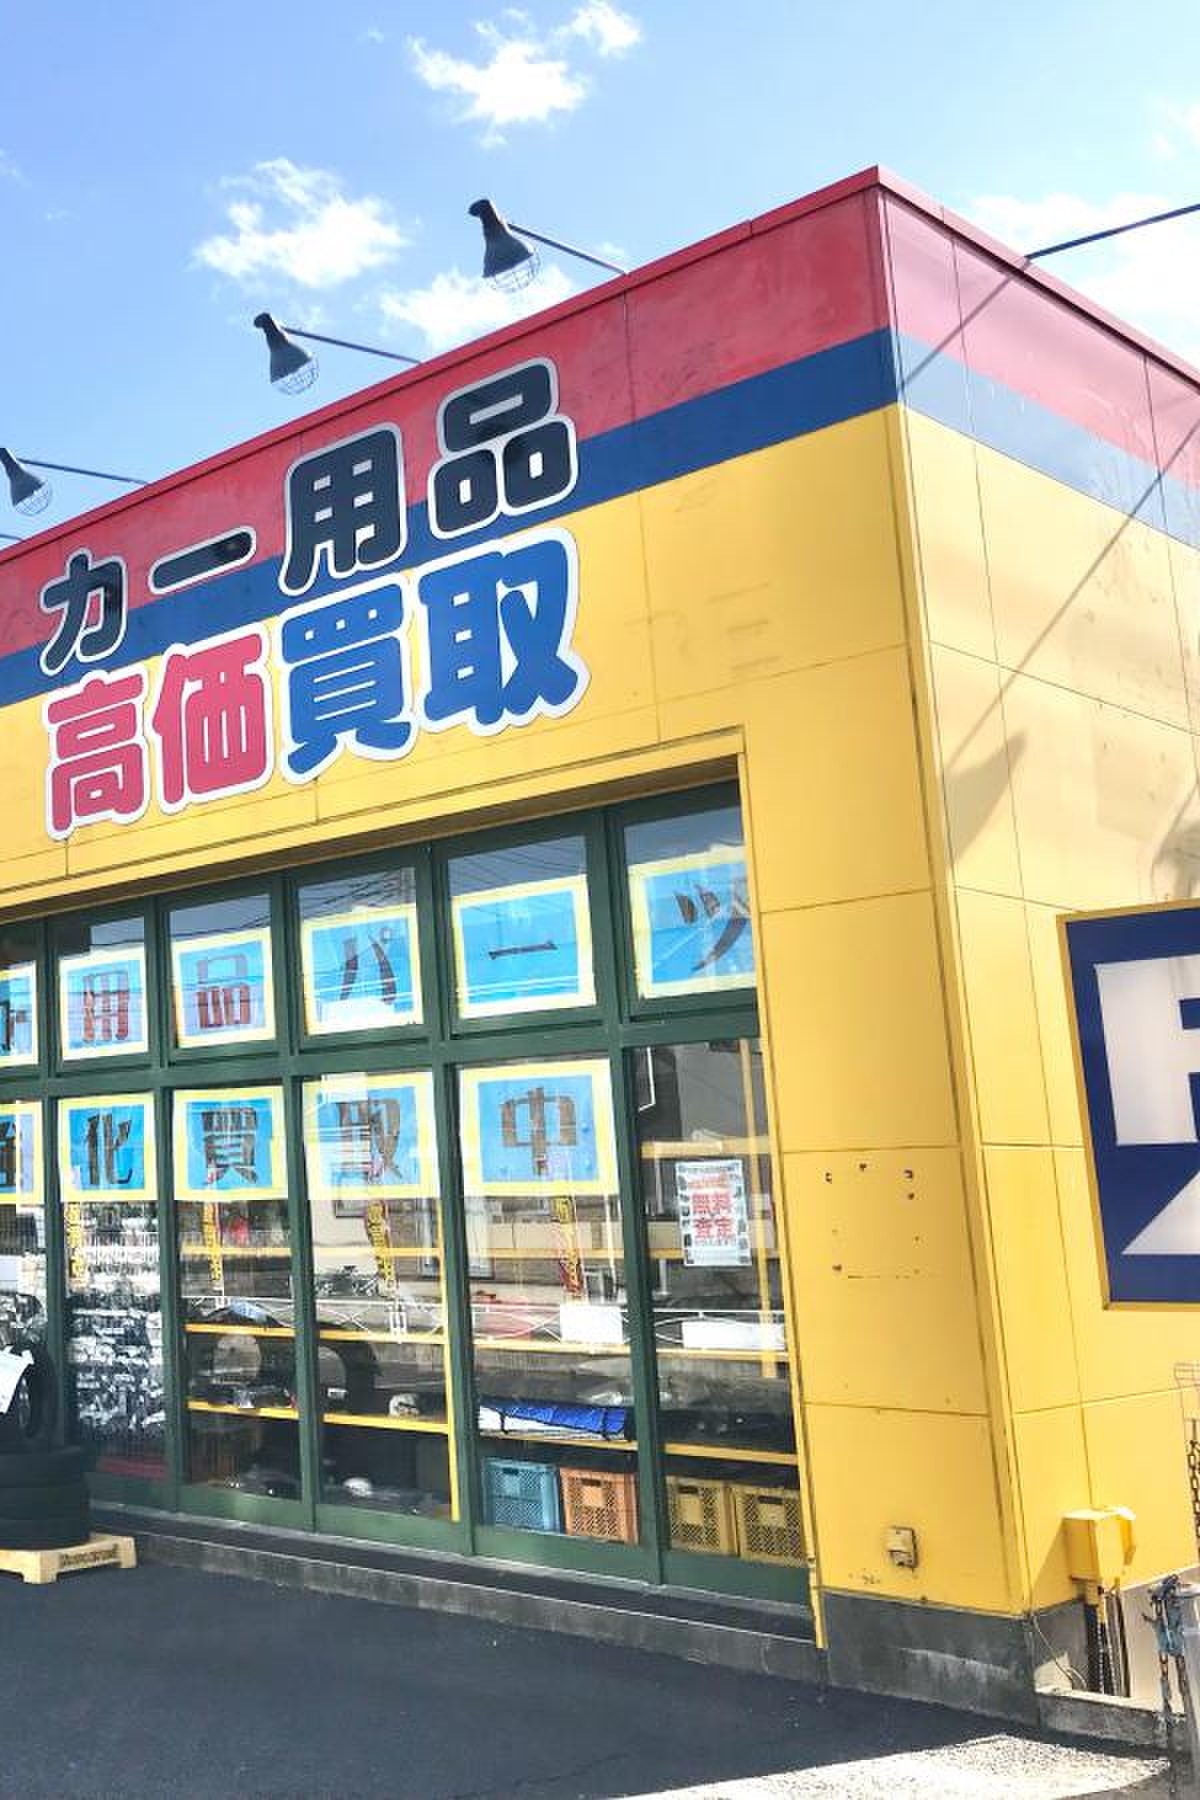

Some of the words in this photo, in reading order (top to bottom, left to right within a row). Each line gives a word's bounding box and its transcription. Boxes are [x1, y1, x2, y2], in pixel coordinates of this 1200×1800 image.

[41, 357, 578, 674] カー用品
[45, 529, 590, 839] 高価買取
